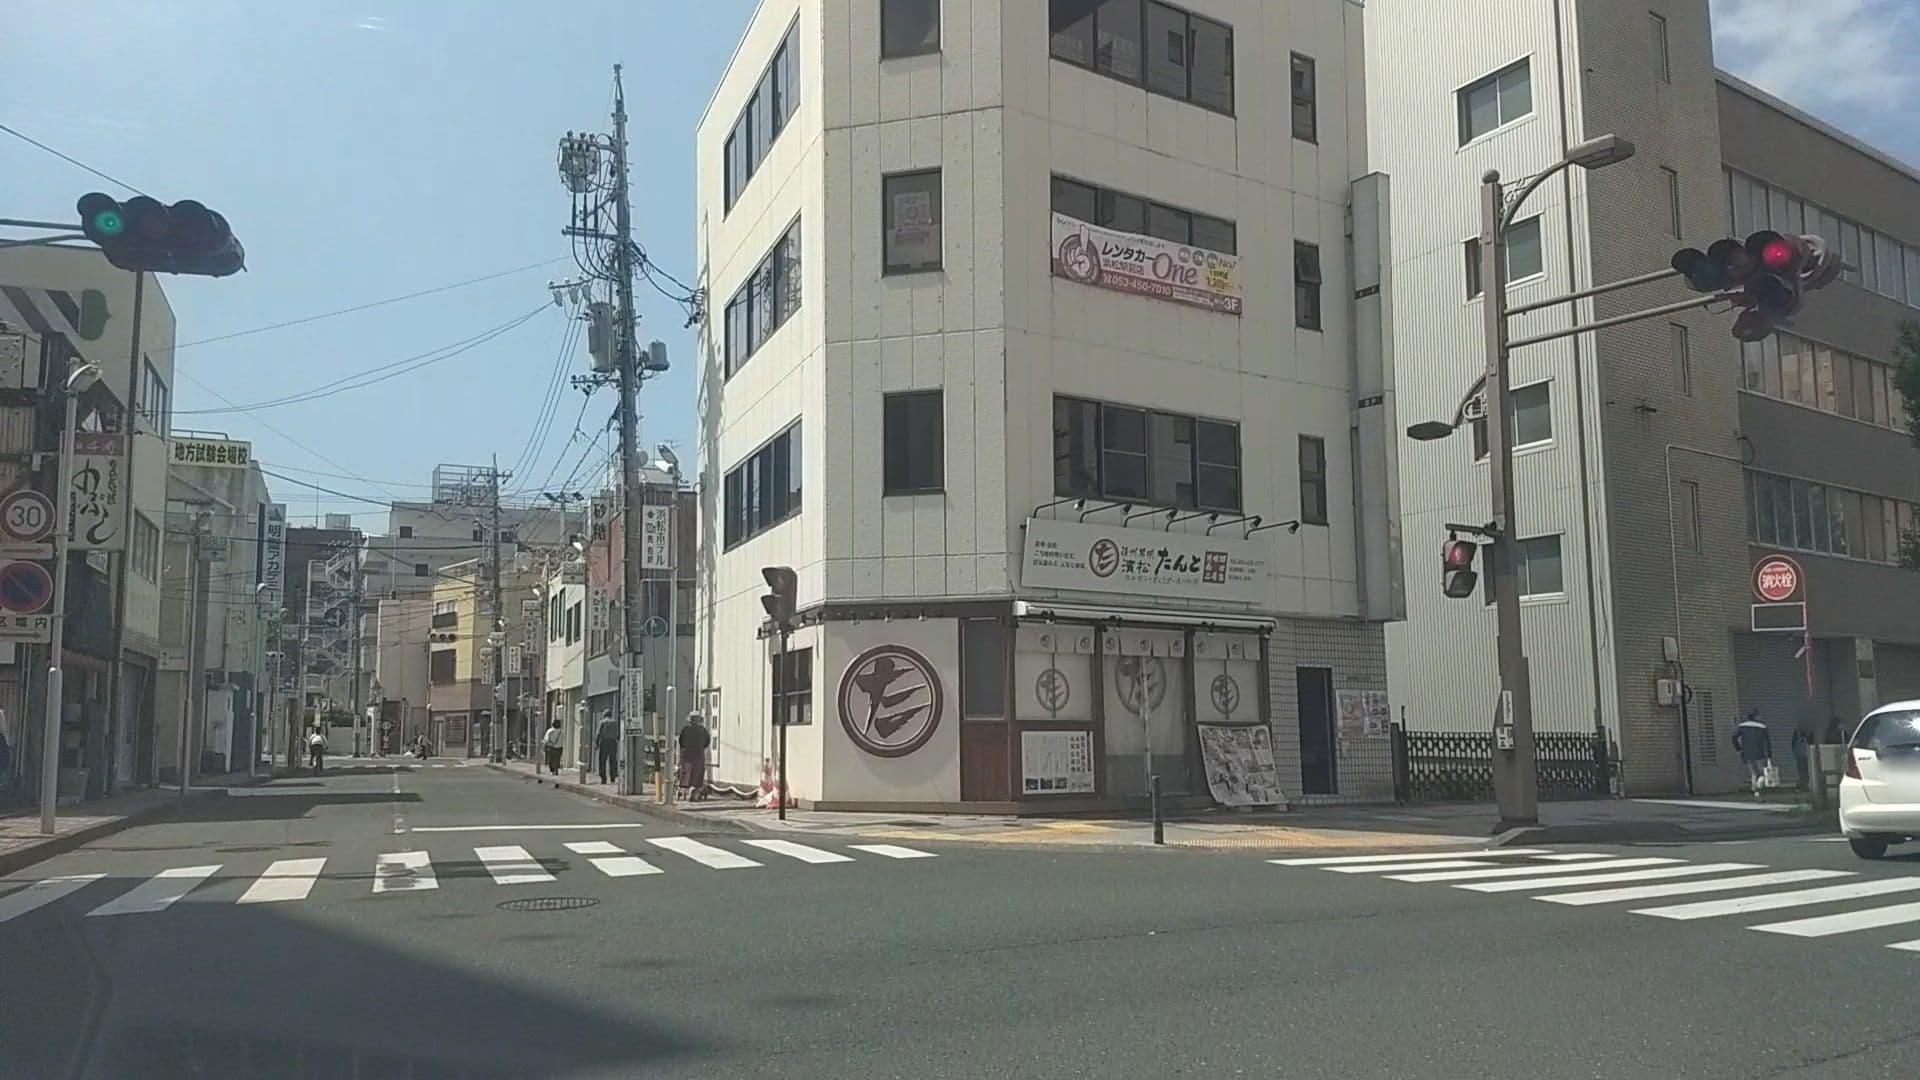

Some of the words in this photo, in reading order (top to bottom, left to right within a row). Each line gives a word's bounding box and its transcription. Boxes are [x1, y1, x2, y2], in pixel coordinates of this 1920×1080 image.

[1102, 241, 1156, 262] レンタカー
[1151, 252, 1198, 285] One
[1223, 297, 1239, 312] 3F
[174, 442, 248, 466] 地方試験会場校
[11, 505, 42, 528] 30
[592, 503, 607, 540] 砂糖
[1154, 547, 1201, 575] たんと
[1762, 573, 1793, 588] 消火栓
